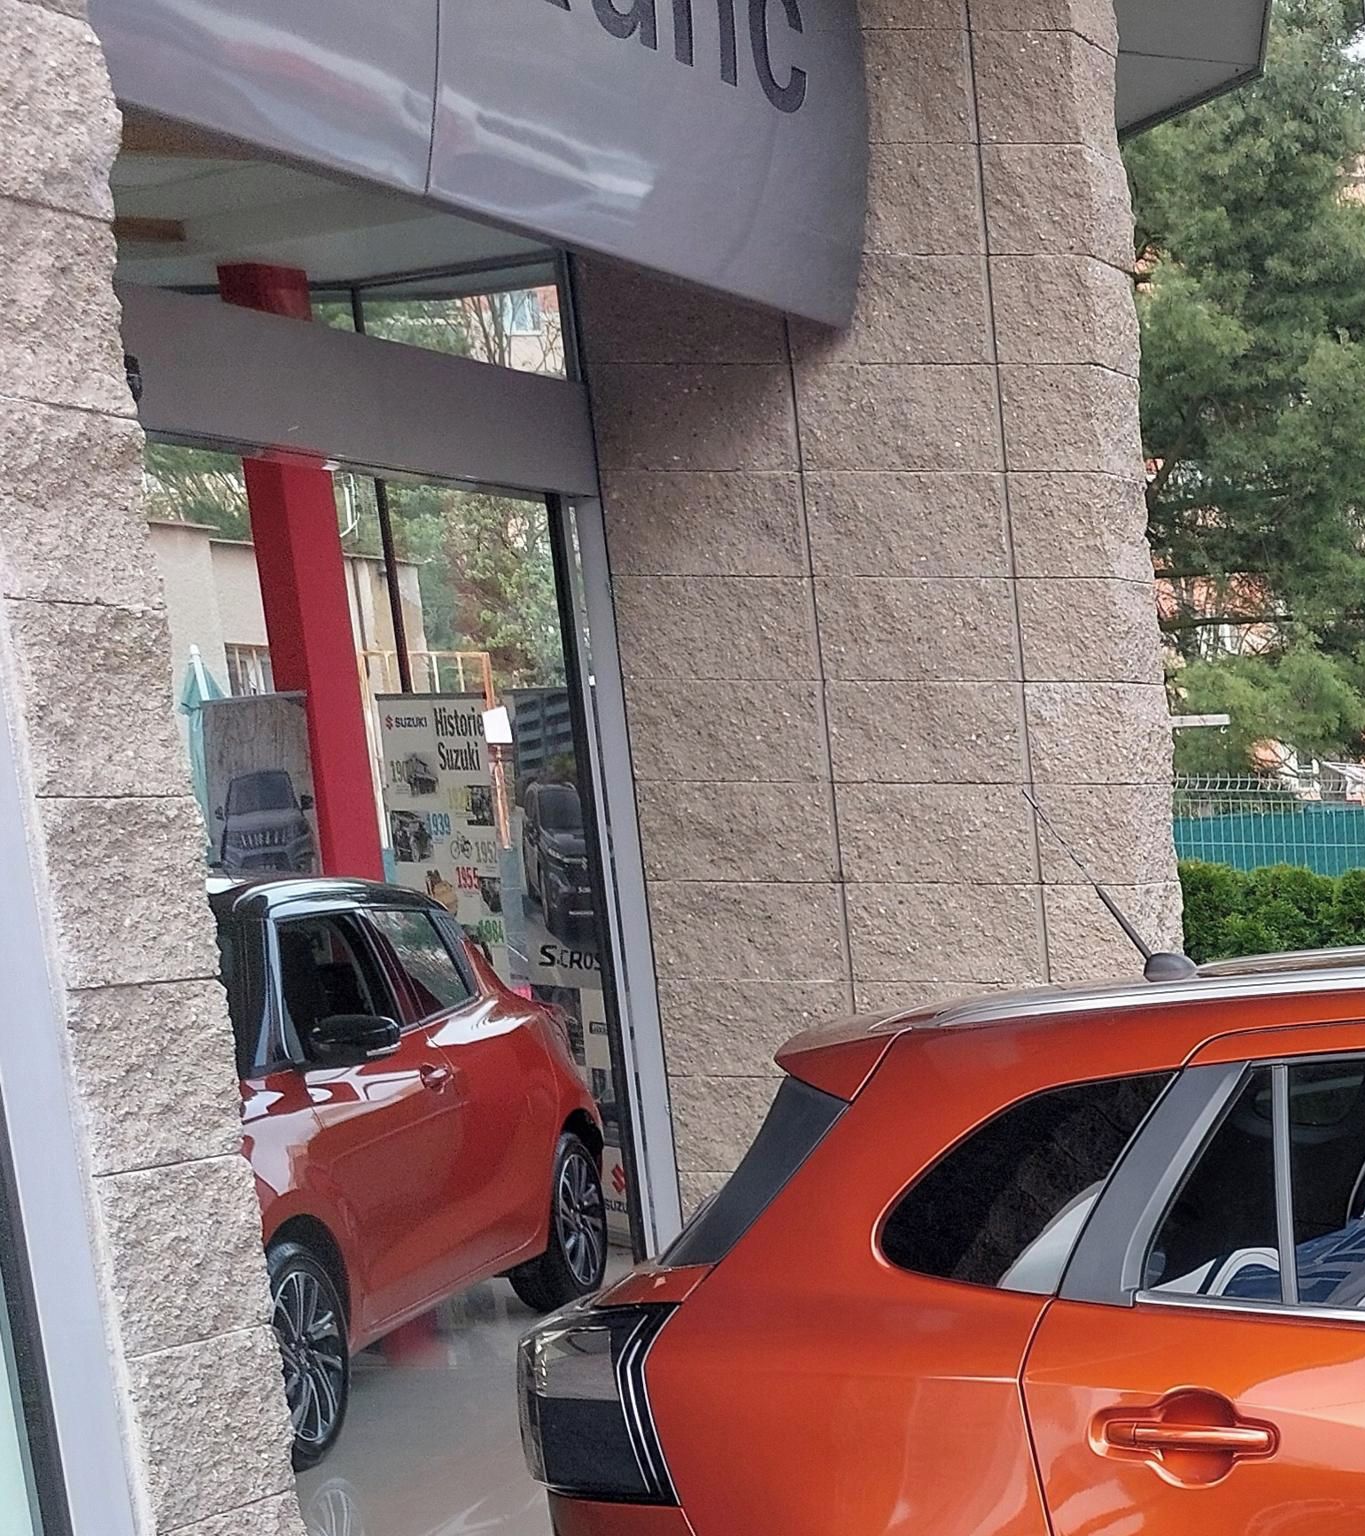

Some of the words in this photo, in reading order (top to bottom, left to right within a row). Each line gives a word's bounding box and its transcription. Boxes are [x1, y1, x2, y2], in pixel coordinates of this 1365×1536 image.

[395, 716, 428, 729] SUZUKI
[433, 706, 485, 737] Historie
[438, 742, 481, 771] Suzuki
